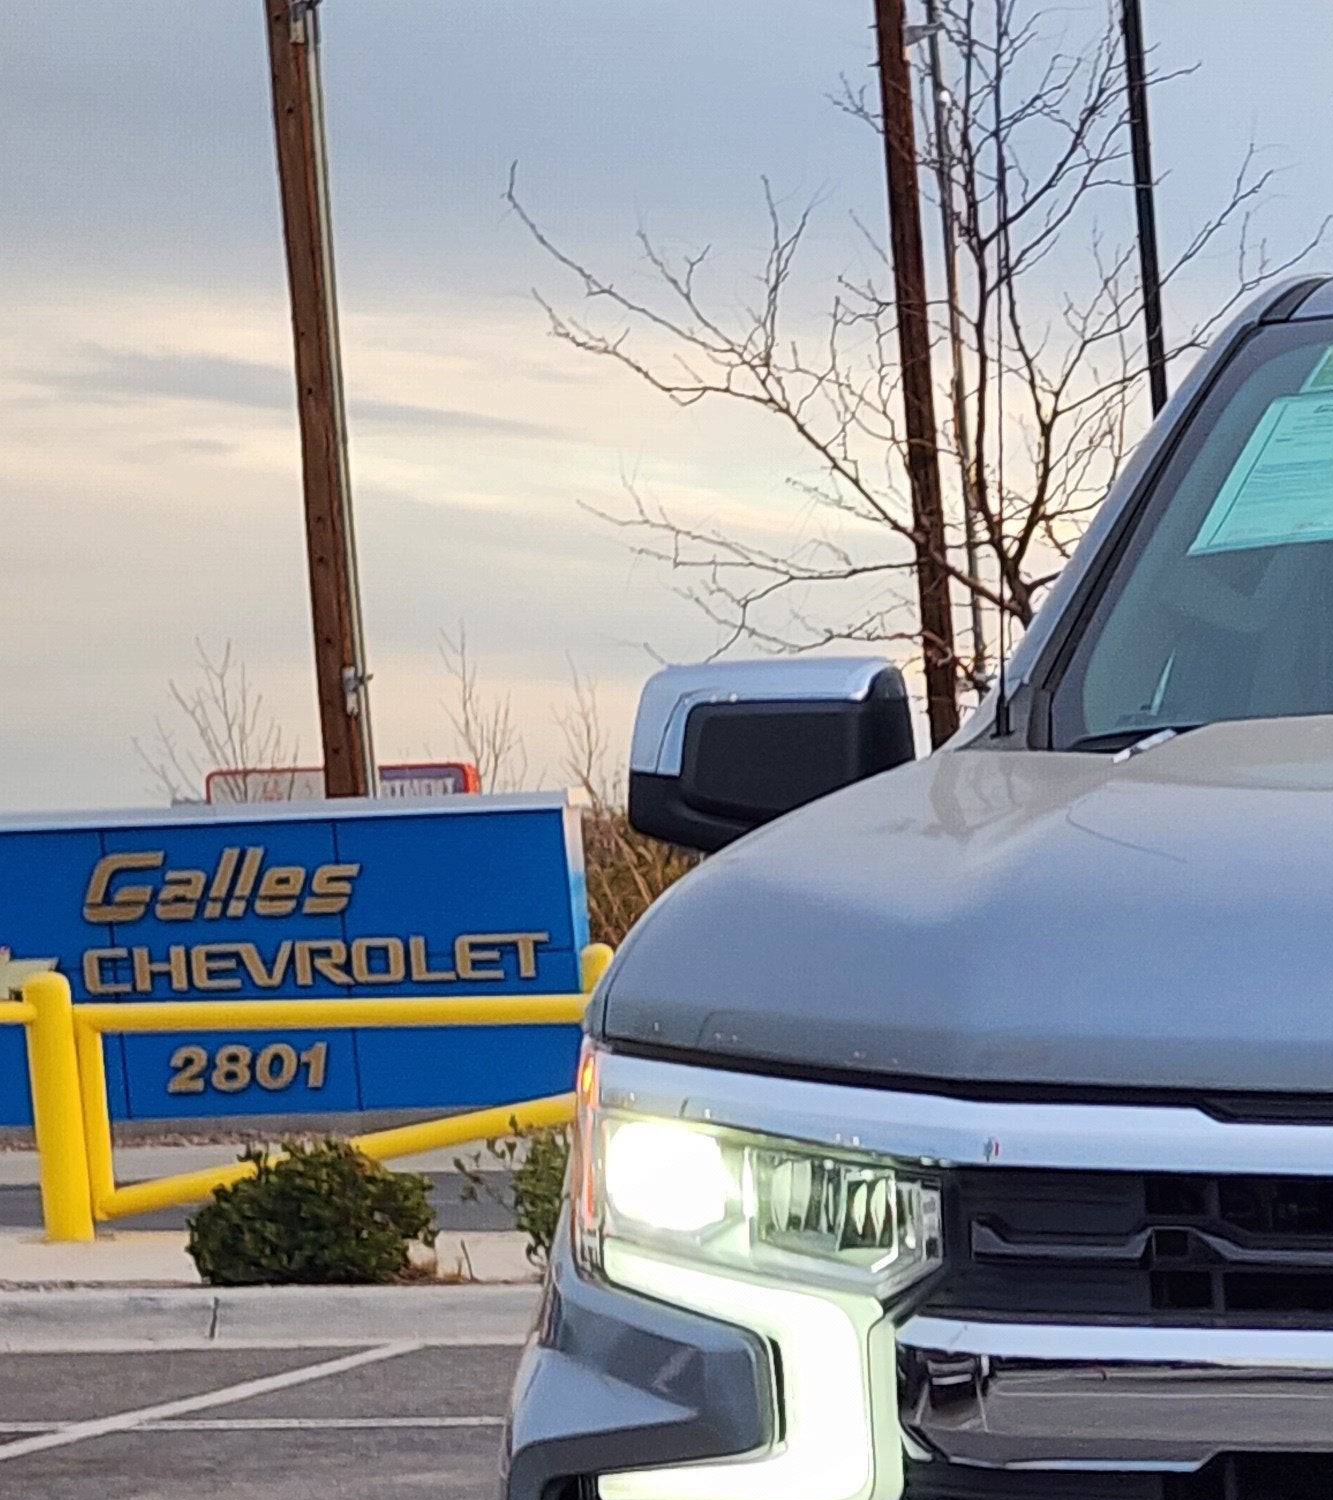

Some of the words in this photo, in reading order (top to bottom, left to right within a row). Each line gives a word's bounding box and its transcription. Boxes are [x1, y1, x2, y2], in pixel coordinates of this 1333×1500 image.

[82, 846, 361, 924] Galles
[82, 931, 550, 996] CHEVROLET
[167, 1041, 328, 1094] 2801
